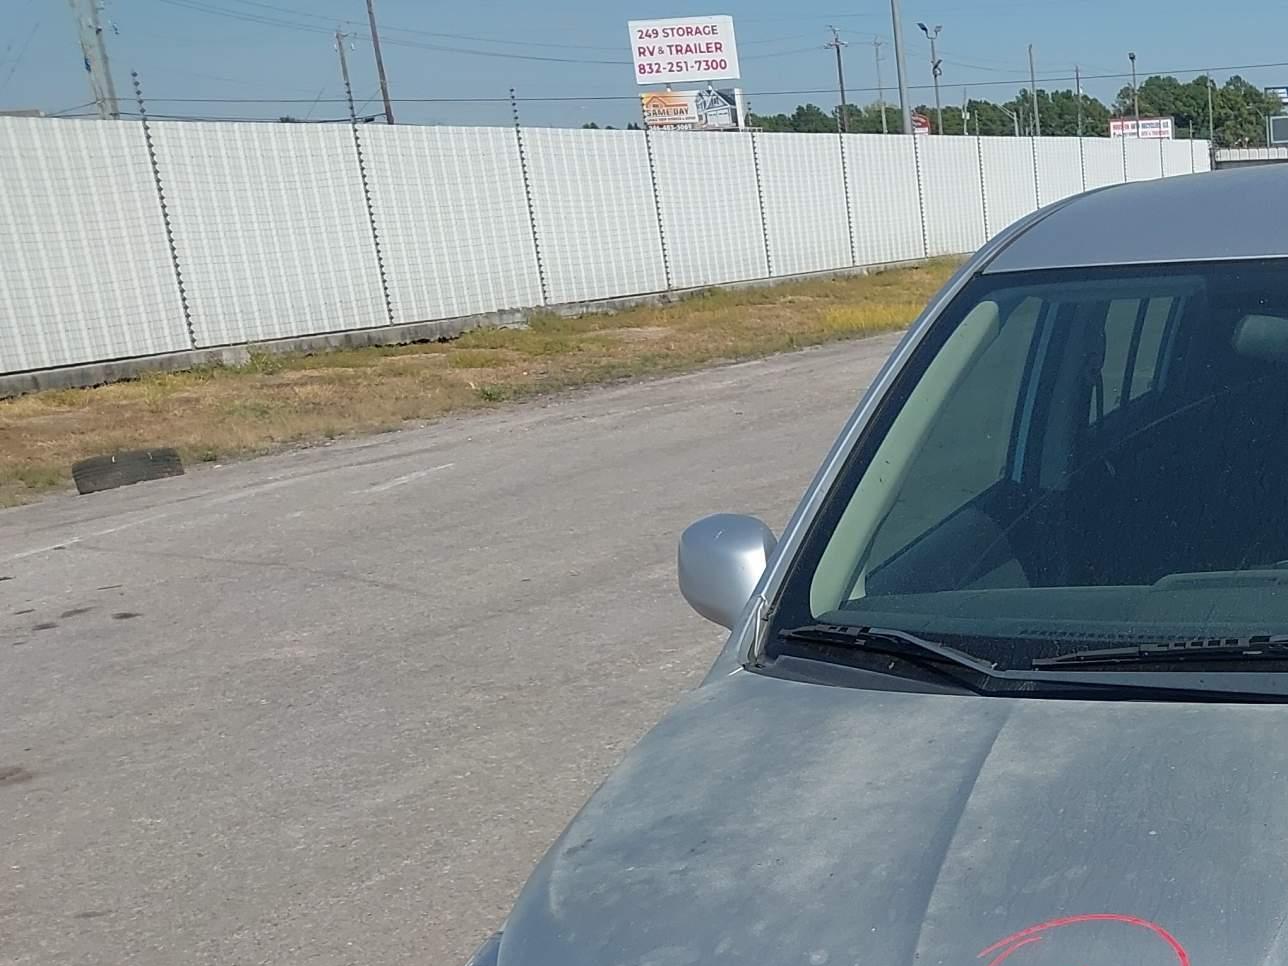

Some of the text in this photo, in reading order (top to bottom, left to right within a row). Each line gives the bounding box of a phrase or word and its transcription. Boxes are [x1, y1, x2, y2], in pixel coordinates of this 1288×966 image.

[637, 25, 719, 39] 249 STORAGE
[637, 42, 723, 57] RV & TRAILER
[638, 59, 728, 75] 832-251-7300
[646, 107, 689, 117] SAME DAY
